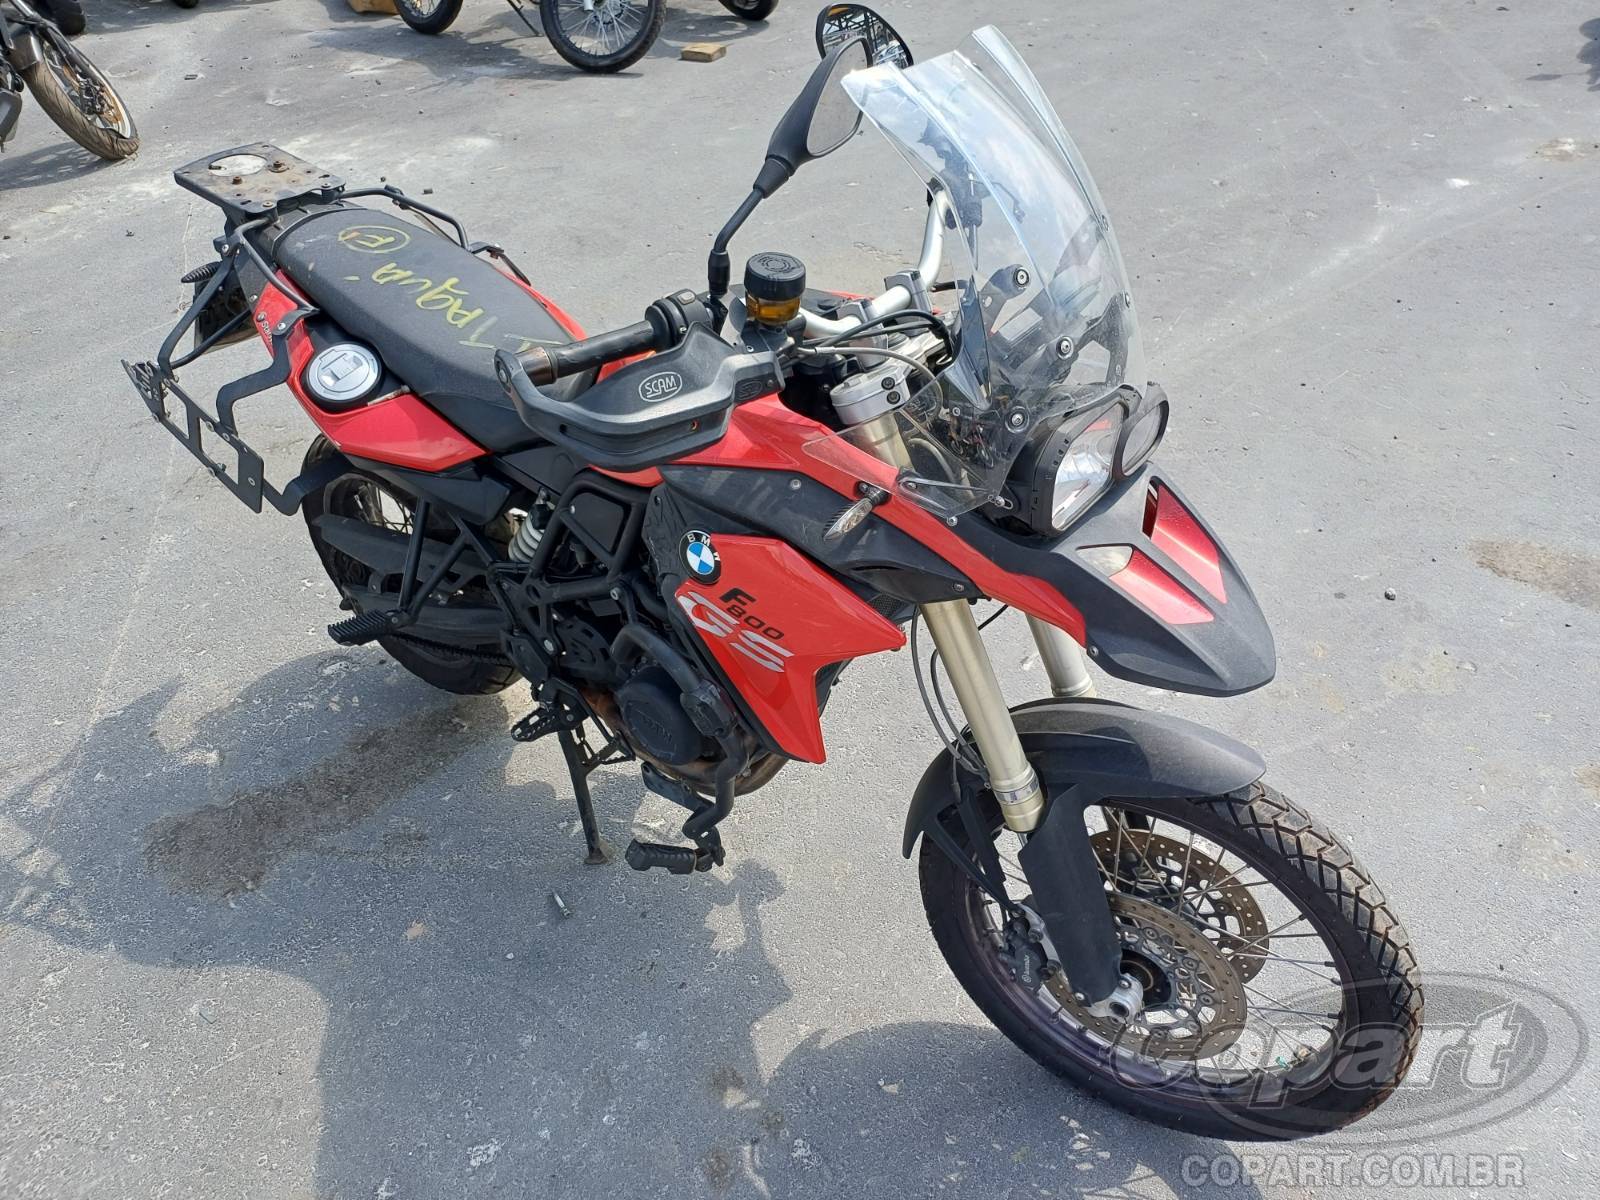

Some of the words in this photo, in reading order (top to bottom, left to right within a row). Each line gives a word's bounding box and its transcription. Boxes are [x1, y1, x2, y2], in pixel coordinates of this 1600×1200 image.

[644, 375, 678, 398] SCAM
[719, 587, 757, 606] F
[677, 591, 795, 673] GS
[726, 604, 785, 640] 800
